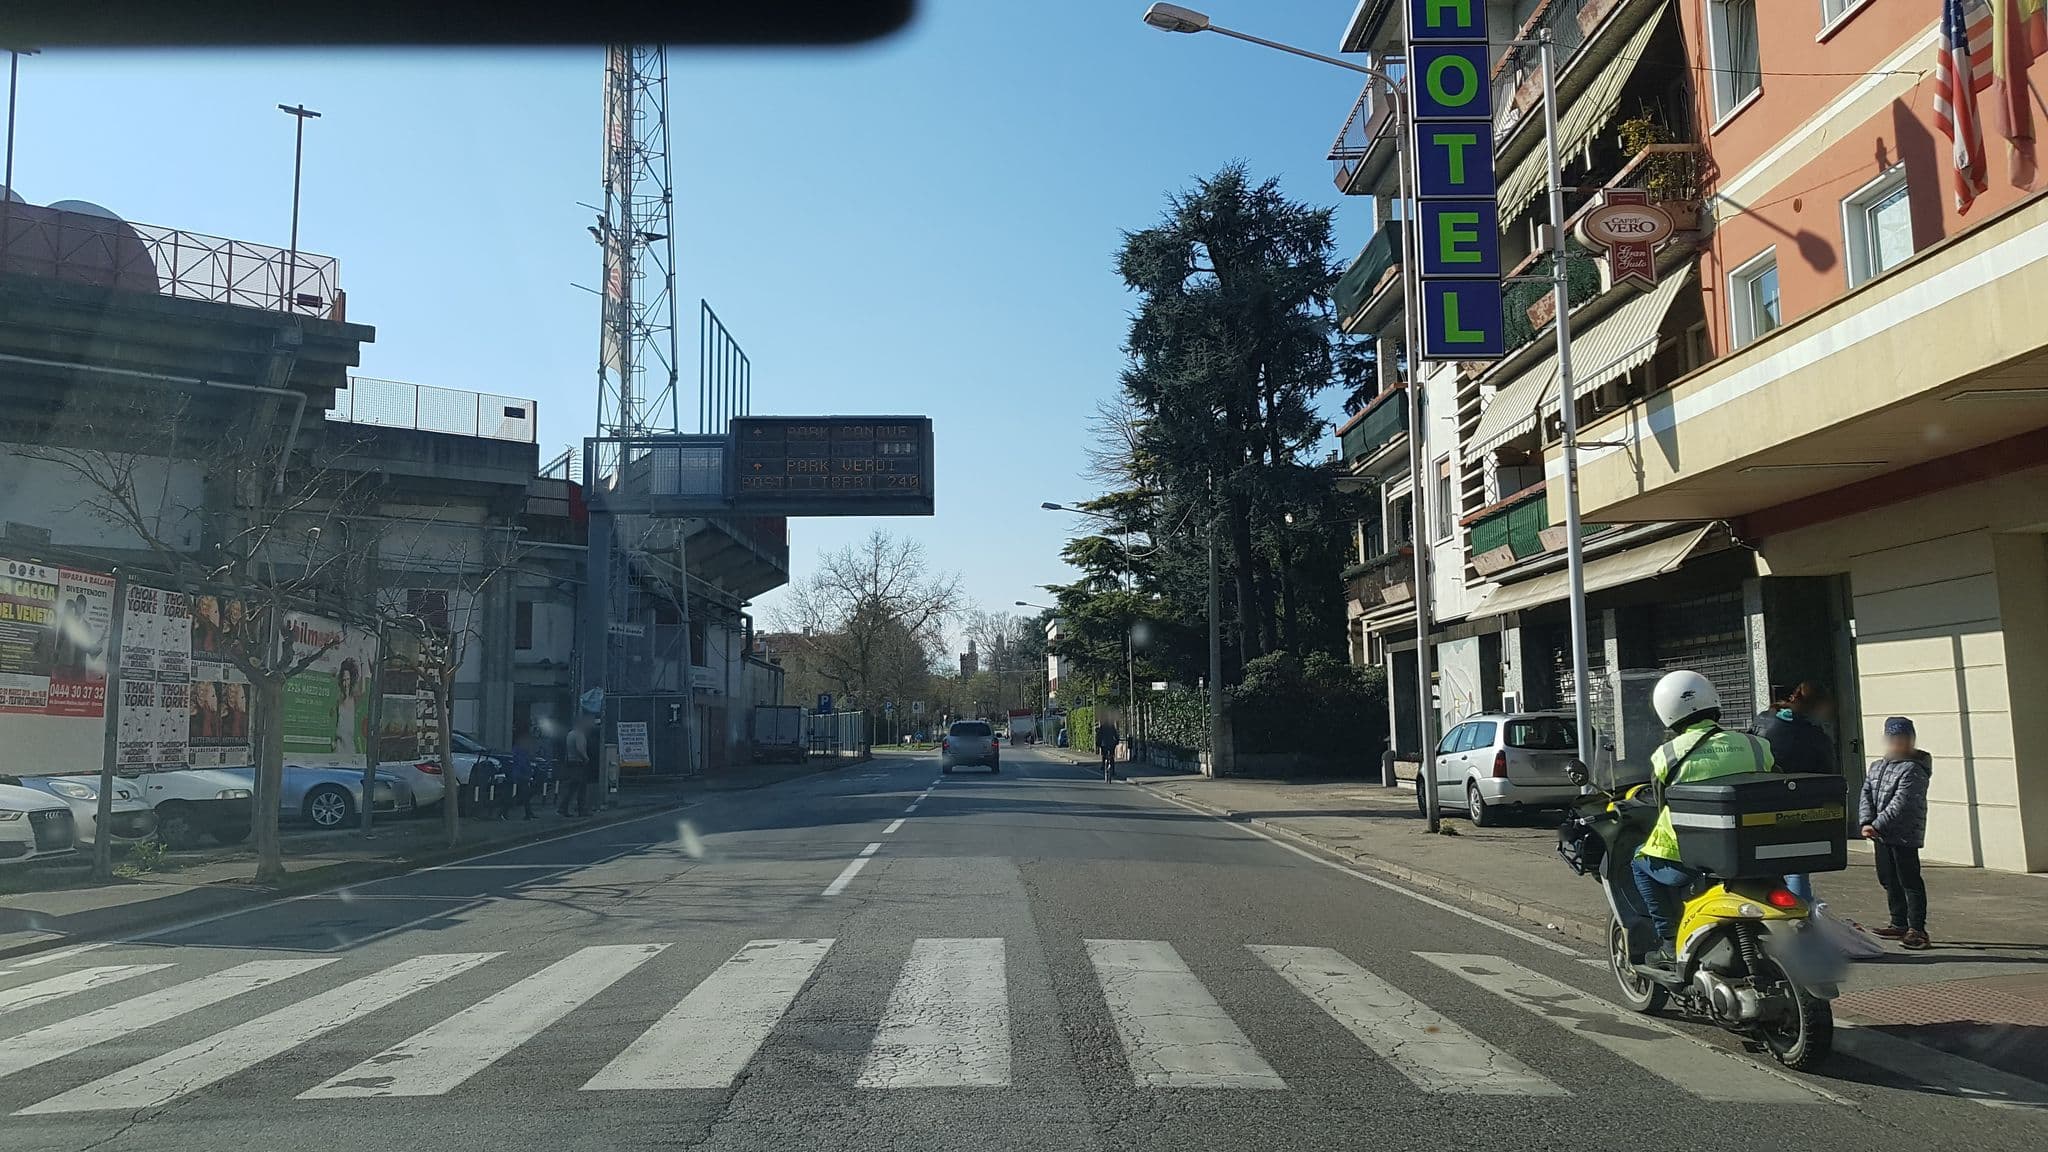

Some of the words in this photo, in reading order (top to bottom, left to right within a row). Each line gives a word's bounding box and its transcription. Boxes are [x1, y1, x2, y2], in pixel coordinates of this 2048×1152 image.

[1426, 0, 1486, 344] HOTEL
[1603, 221, 1656, 233] VERO
[1617, 245, 1646, 259] Gran
[1618, 257, 1647, 269] Gusto
[786, 459, 829, 472] PARK
[842, 459, 896, 472] VERDI
[66, 585, 107, 598] DIVERTENDOTI
[127, 599, 158, 615] YORKE
[17, 604, 56, 625] VENETO
[50, 683, 70, 697] 0444
[71, 684, 82, 698] 30
[83, 686, 93, 699] 37
[94, 687, 105, 700] 32
[124, 694, 155, 707] YORKE
[160, 696, 189, 708] YORKE
[821, 695, 829, 705] P
